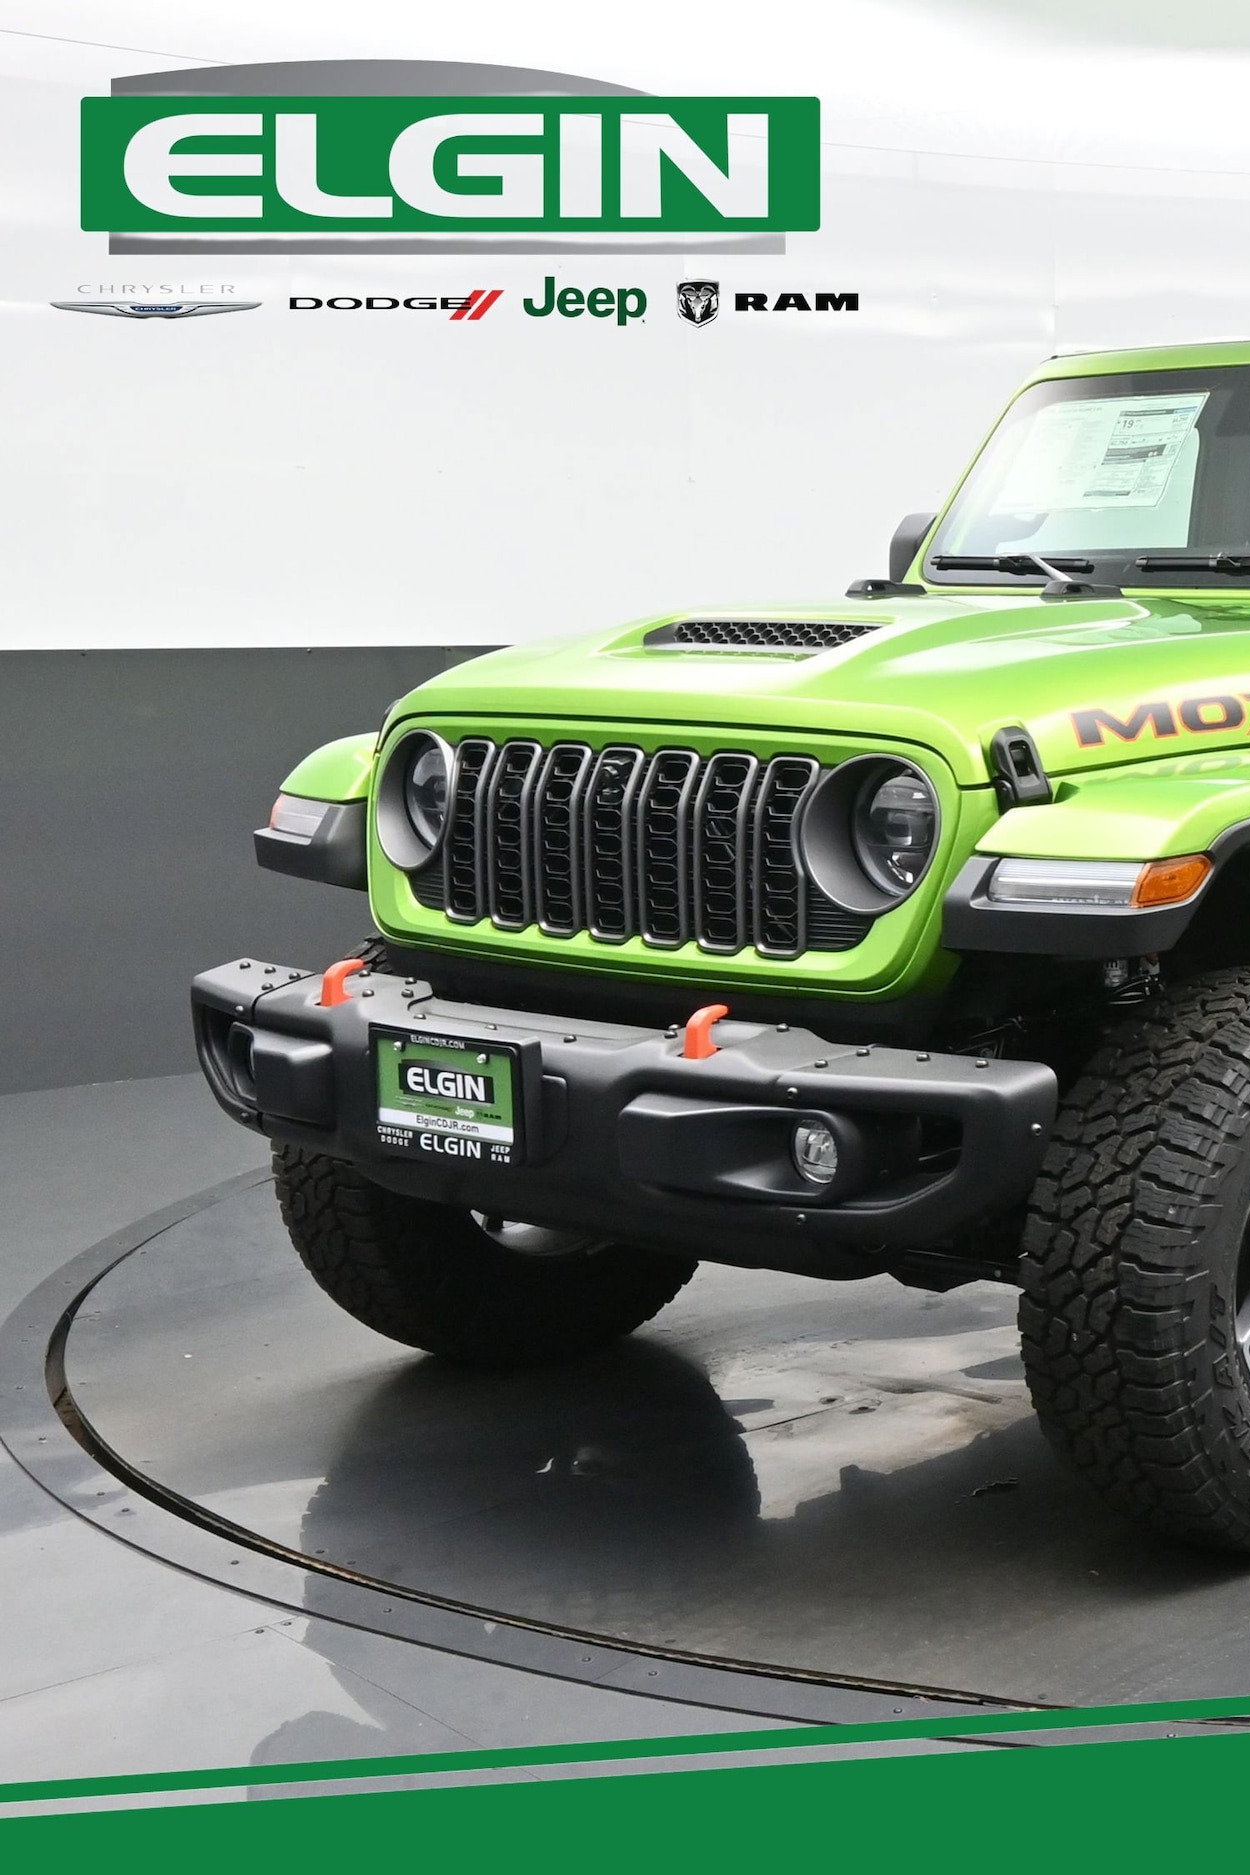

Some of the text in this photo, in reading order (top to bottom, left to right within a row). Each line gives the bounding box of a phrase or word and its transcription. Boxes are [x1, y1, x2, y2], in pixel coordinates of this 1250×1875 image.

[407, 1067, 486, 1101] ELGIN
[455, 1106, 474, 1119] Jeep
[416, 1115, 480, 1134] ElginCDJR.com
[377, 1126, 413, 1139] CHRYSLER
[381, 1135, 409, 1147] DODGE
[420, 1133, 481, 1159] ELGIN
[490, 1145, 511, 1155] JEEP
[491, 1153, 511, 1164] RAM
